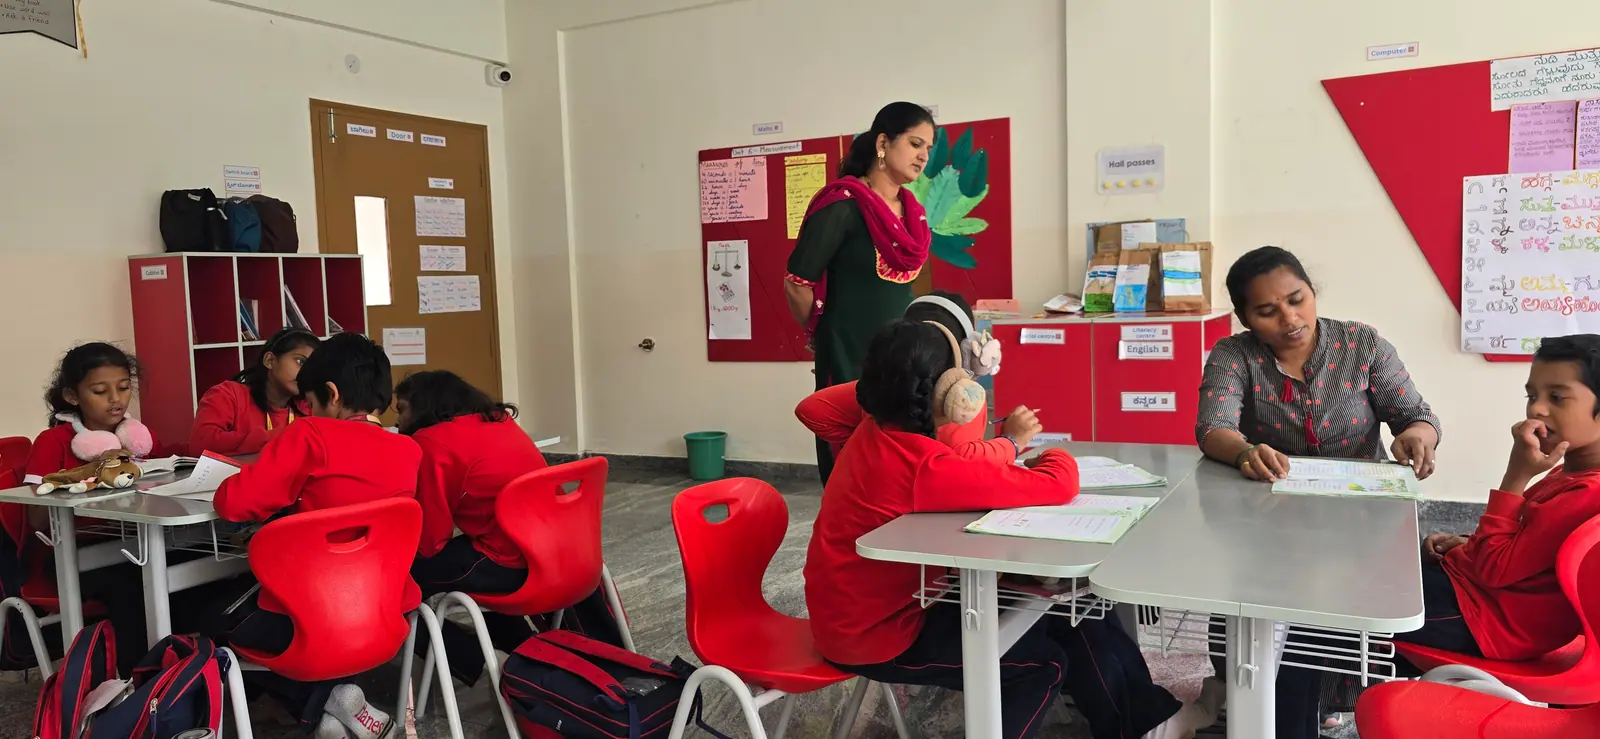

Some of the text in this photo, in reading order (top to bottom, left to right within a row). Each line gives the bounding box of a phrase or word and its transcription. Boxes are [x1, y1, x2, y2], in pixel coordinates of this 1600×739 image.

[28, 15, 49, 24] friend
[1371, 48, 1407, 56] Computer
[391, 131, 406, 140] Door
[760, 143, 799, 152] Measurement
[1108, 159, 1155, 168] Hall passes
[1127, 345, 1159, 354] English
[1133, 397, 1157, 408] ಕನ್ನಡ
